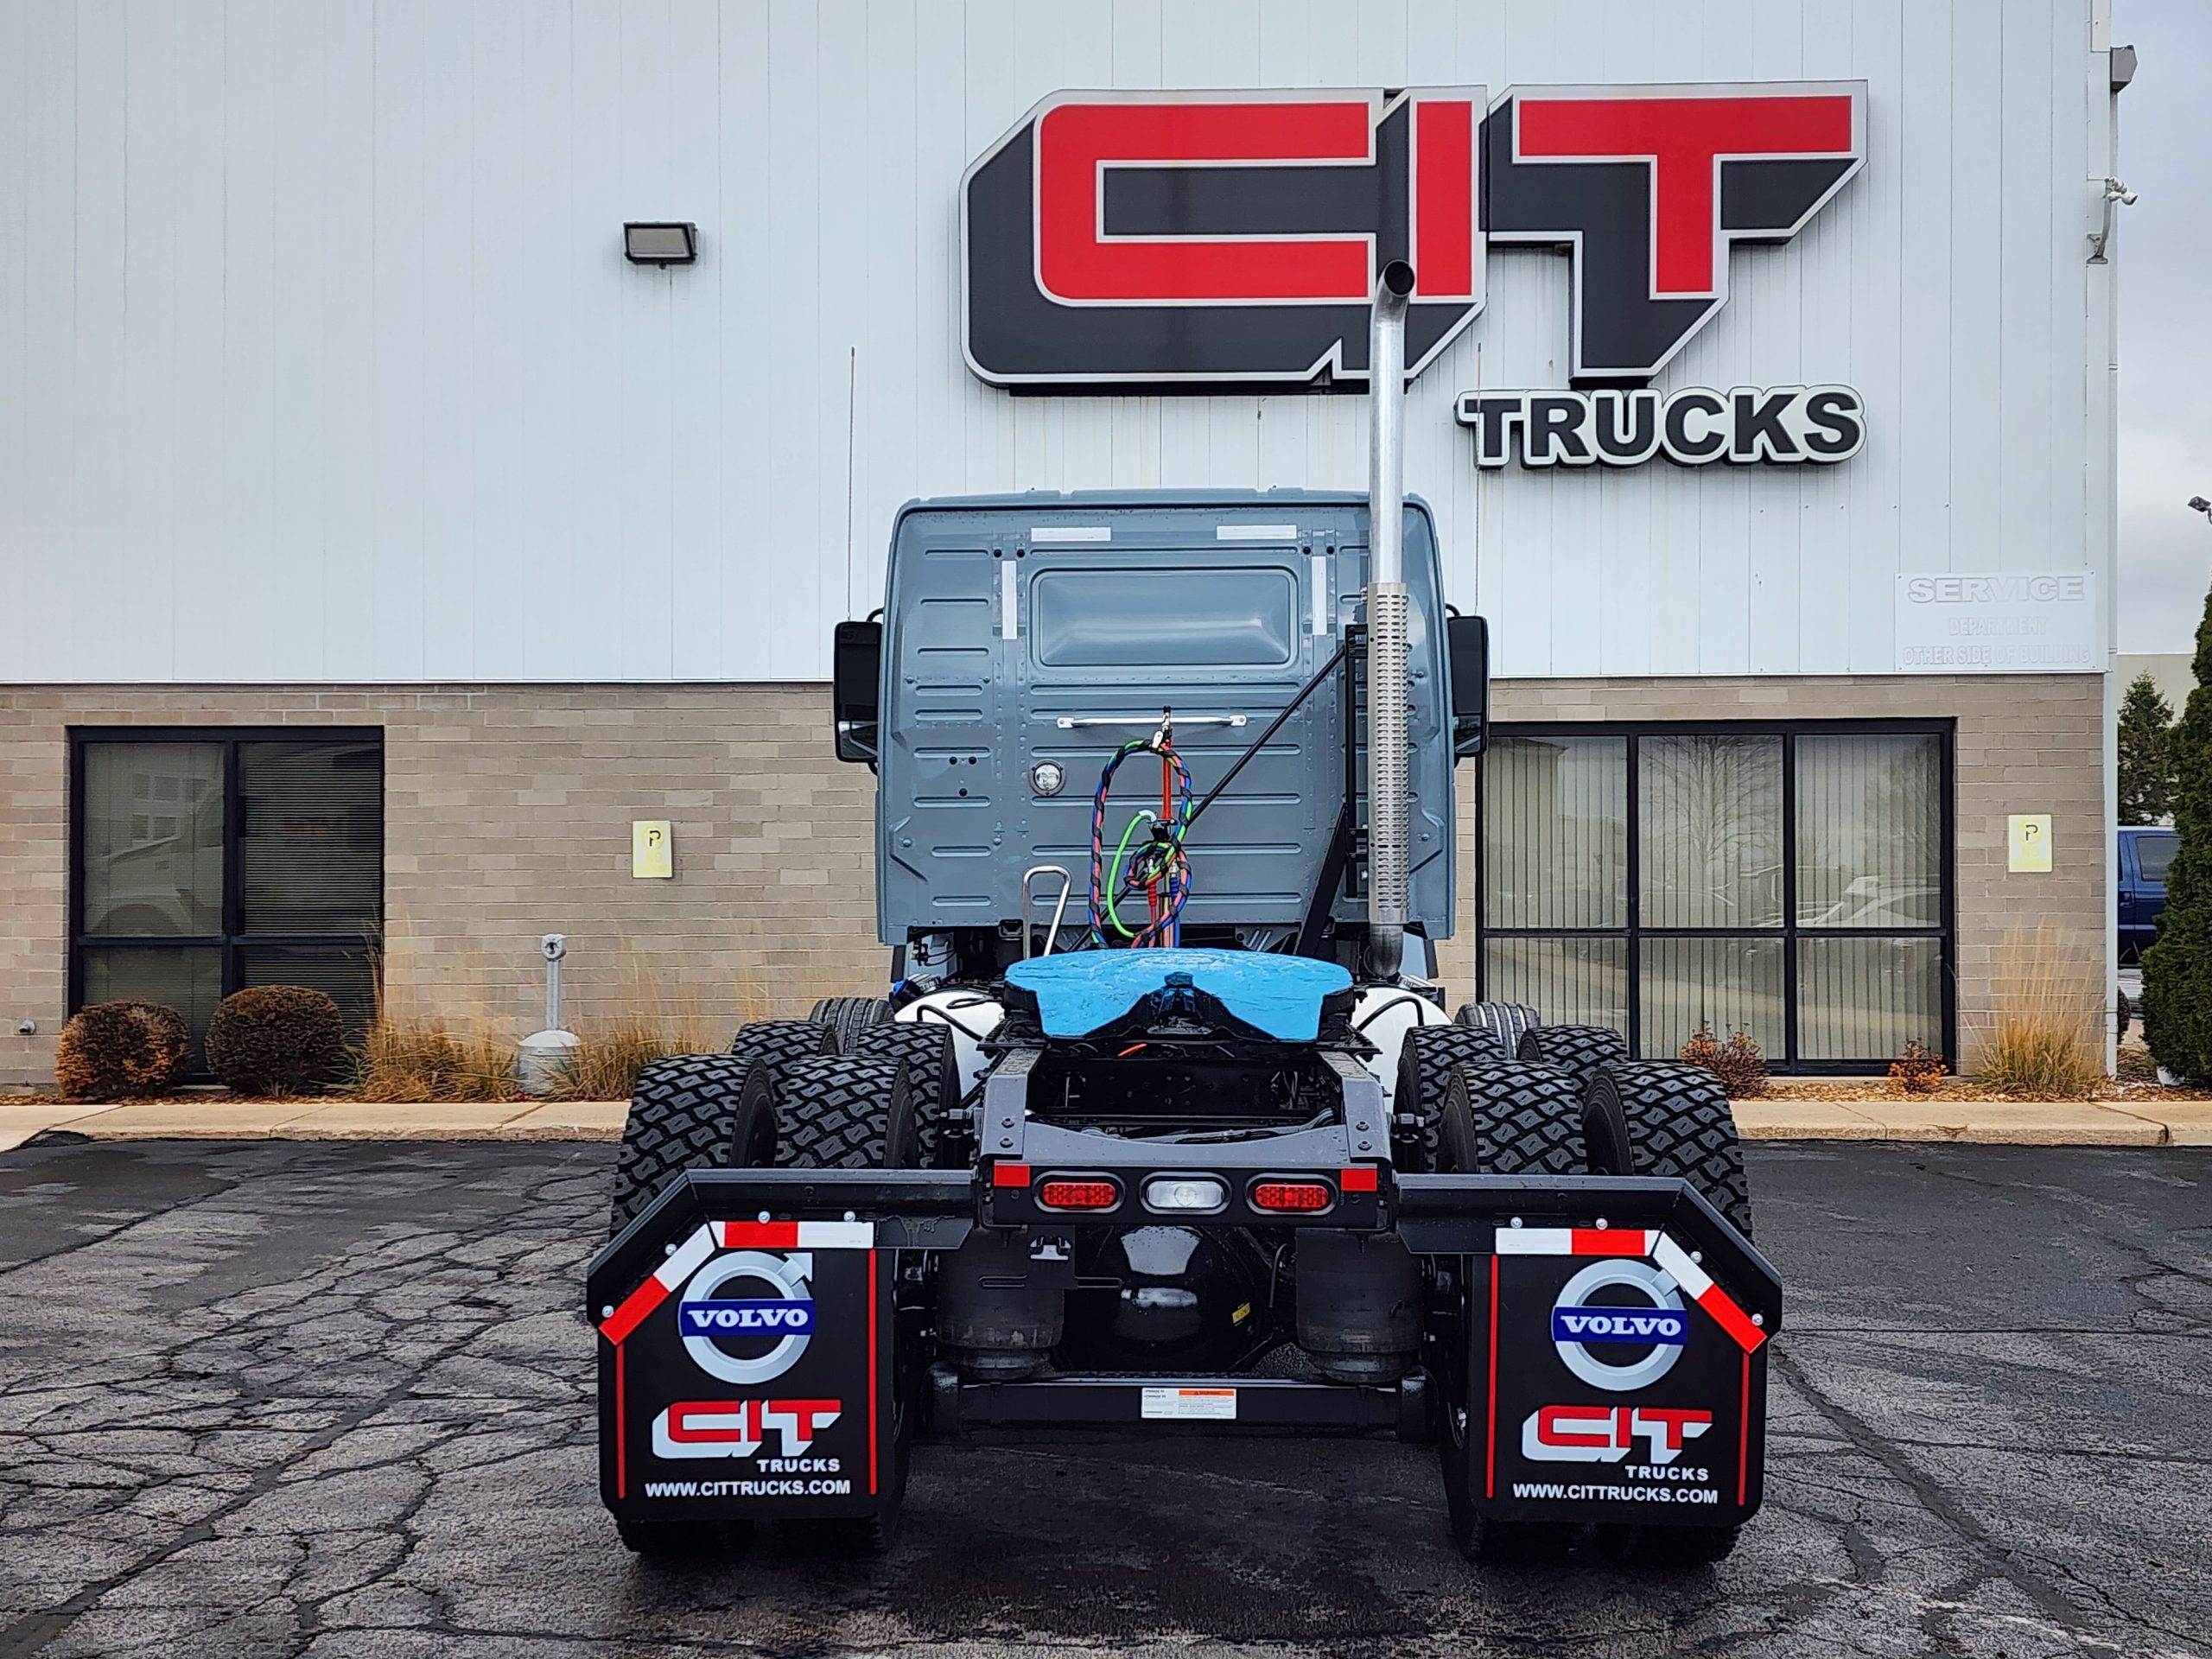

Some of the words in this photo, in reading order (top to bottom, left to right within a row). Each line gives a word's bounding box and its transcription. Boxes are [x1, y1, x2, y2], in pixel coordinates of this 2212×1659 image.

[962, 85, 1866, 384] CIT
[1462, 389, 1863, 464] TRUCKS
[1908, 575, 2084, 603] SERVICE
[1904, 646, 1955, 665] OTHER
[1956, 645, 1991, 664] SIDE
[687, 1308, 809, 1328] VOLVO
[1560, 1315, 1681, 1337] VOLVO
[652, 1399, 842, 1459] CIT
[1522, 1405, 1713, 1464] CIT
[756, 1458, 841, 1472] TRUCKS
[1624, 1465, 1709, 1481] TRUCKS
[645, 1479, 851, 1497] WWW.CITTRUCKS.COM
[1512, 1483, 1719, 1504] WWW.CITTRUCKS.COM
